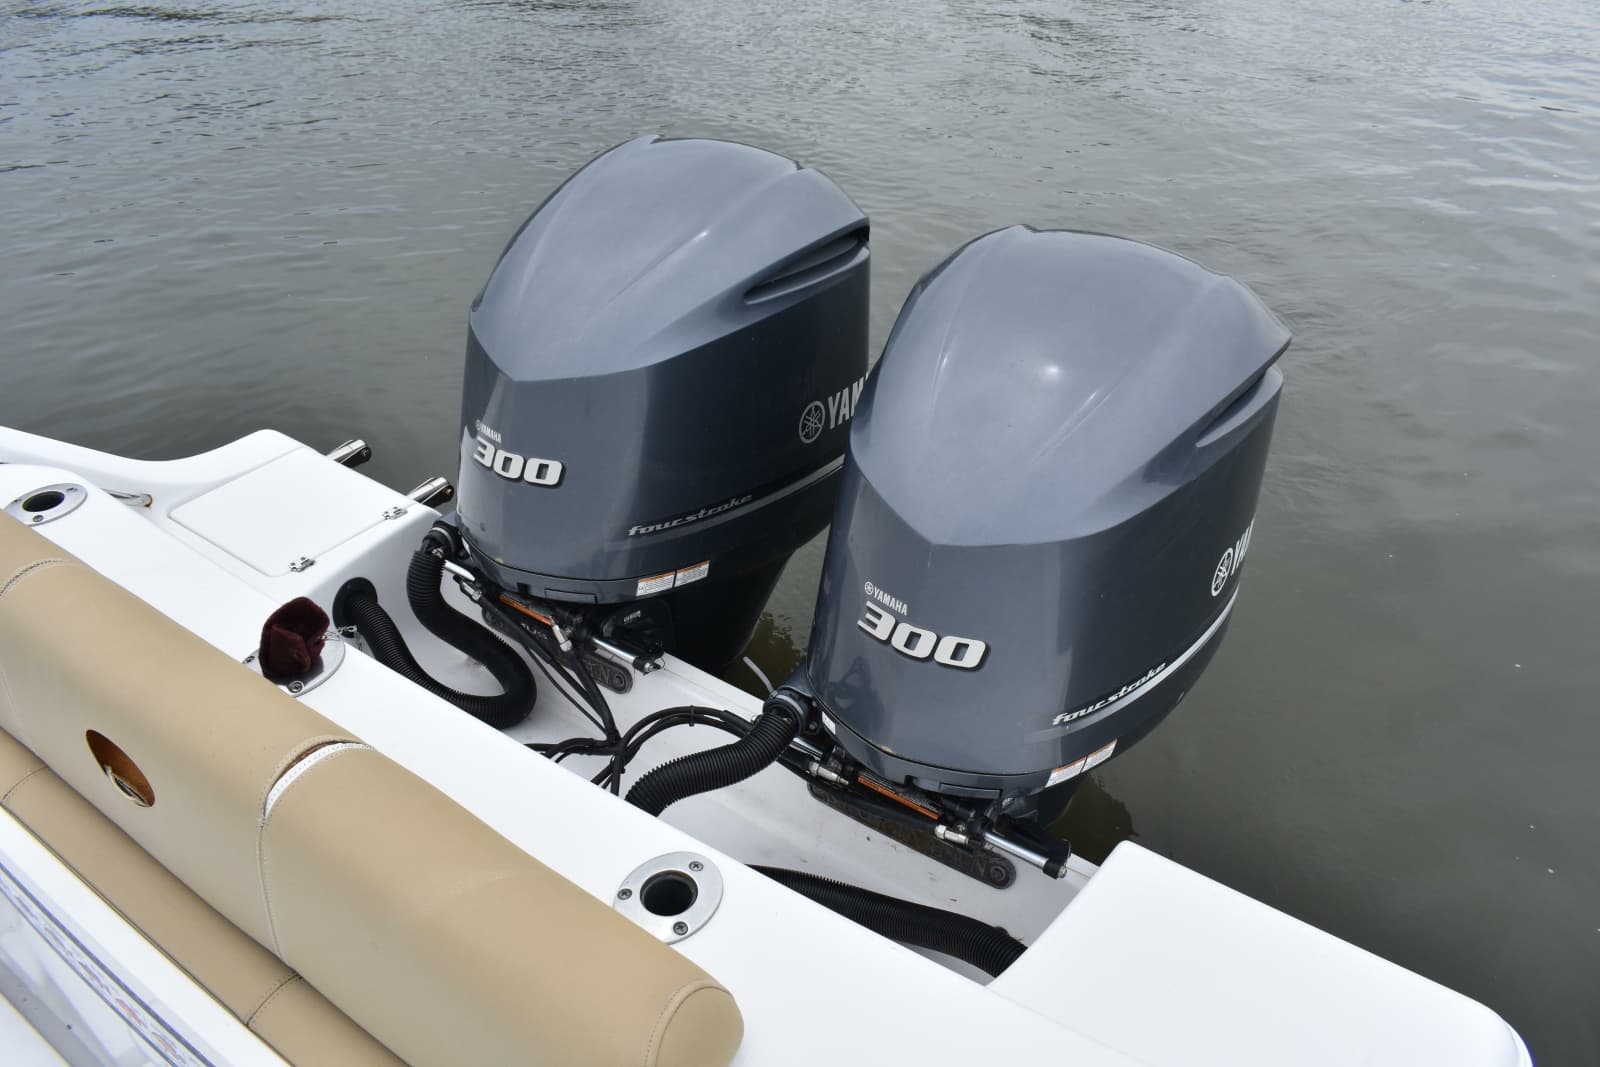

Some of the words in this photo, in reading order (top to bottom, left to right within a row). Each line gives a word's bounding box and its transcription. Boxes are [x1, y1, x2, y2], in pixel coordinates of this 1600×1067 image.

[827, 371, 869, 430] YAM
[480, 423, 502, 443] YAMAHA
[473, 435, 563, 486] 300
[873, 586, 908, 616] YAMAHA
[857, 600, 987, 669] 300
